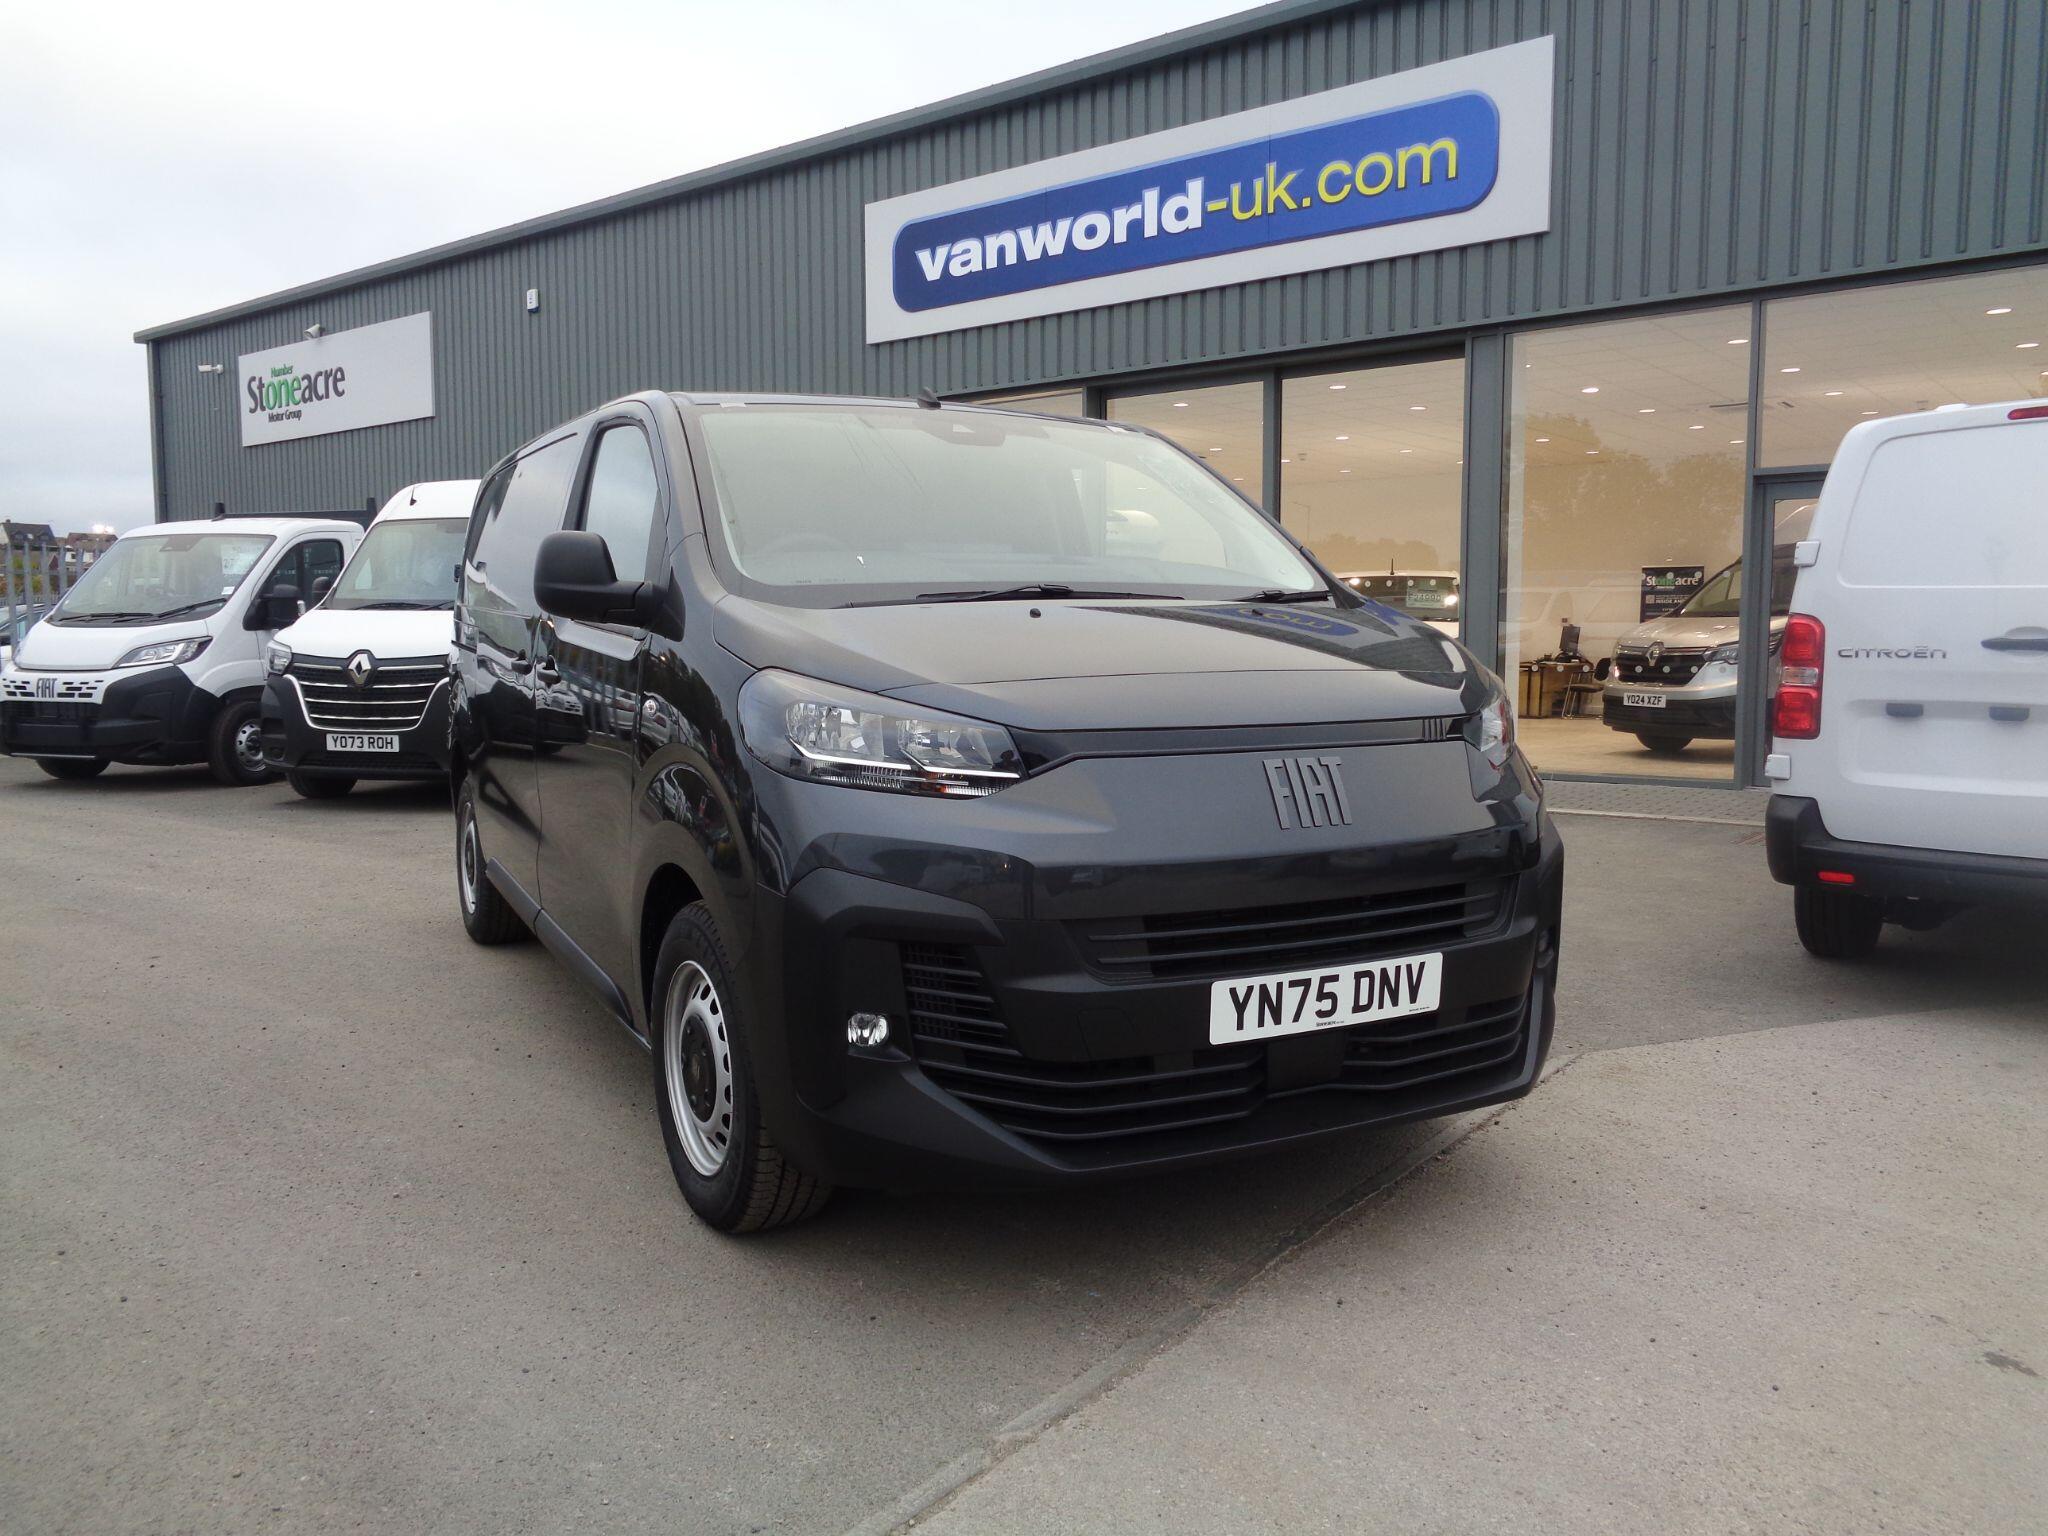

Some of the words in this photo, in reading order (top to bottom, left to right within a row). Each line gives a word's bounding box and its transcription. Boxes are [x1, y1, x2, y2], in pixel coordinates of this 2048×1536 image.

[915, 137, 1458, 282] vanworld-uk.com
[247, 367, 346, 413] Stoneacre
[268, 412, 284, 423] Motor
[285, 410, 302, 421] Group
[36, 677, 58, 698] FIAT
[1646, 695, 1663, 706] XZF
[367, 736, 394, 750] ROH
[1262, 756, 1352, 830] FIAT
[1228, 974, 1340, 1031] YN75
[1351, 961, 1426, 1014] DNV
